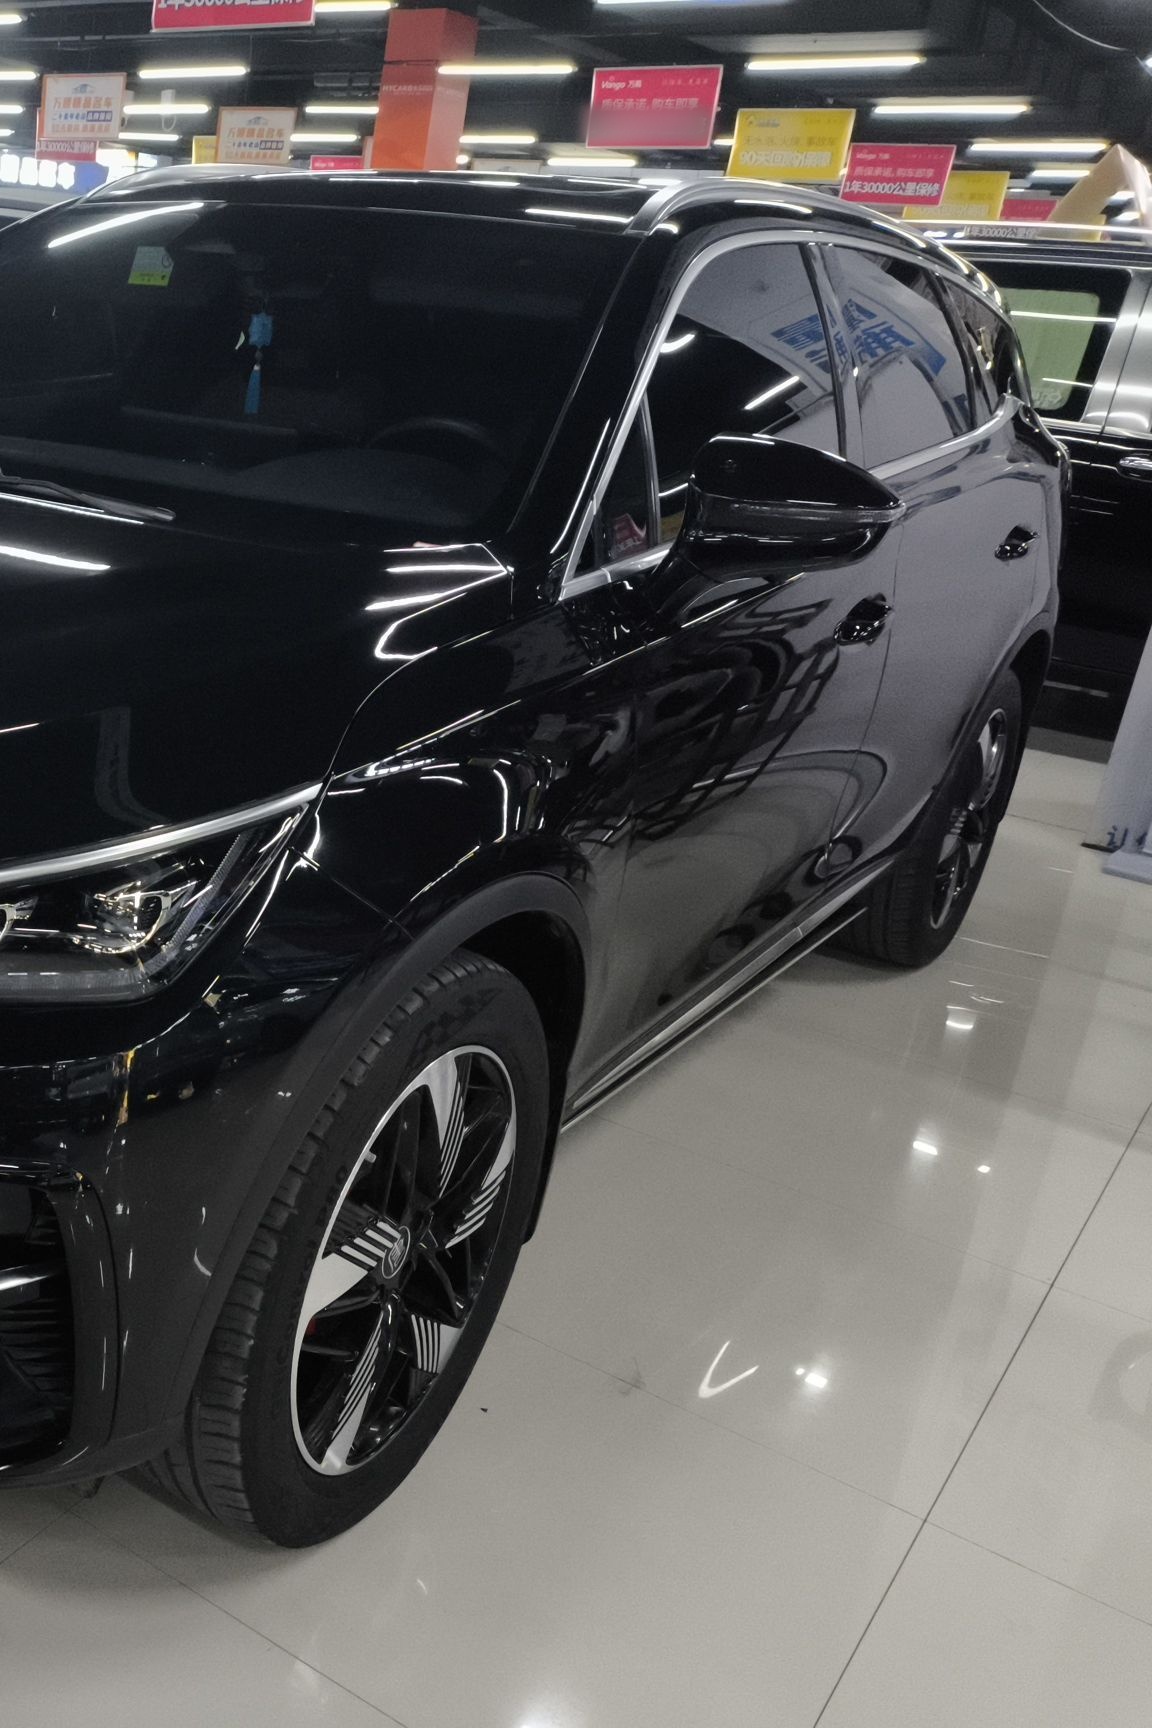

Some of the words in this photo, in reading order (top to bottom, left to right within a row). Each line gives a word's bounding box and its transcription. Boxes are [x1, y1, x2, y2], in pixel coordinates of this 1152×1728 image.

[844, 180, 941, 197] 1年30000公里保修
